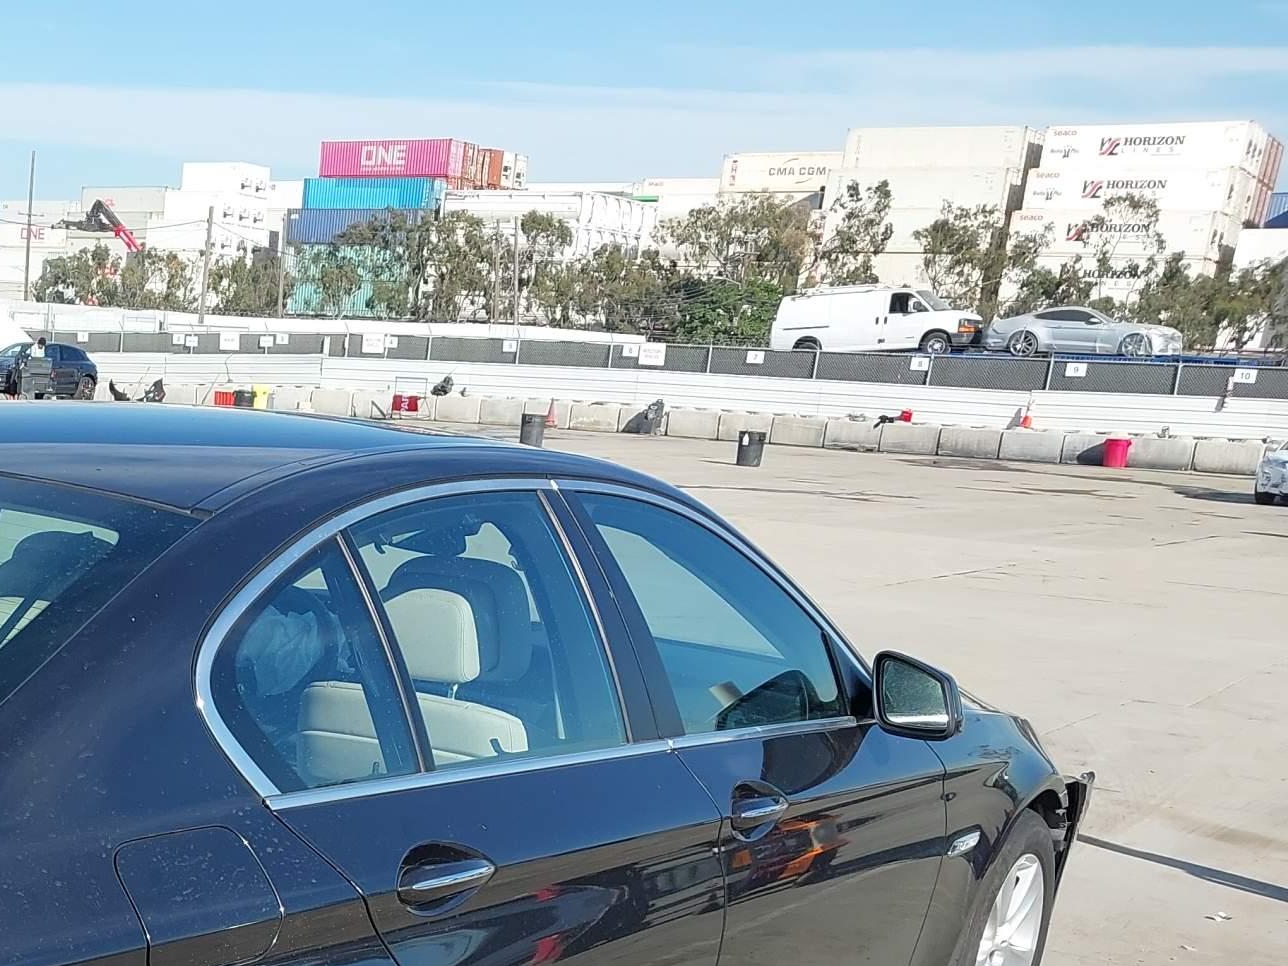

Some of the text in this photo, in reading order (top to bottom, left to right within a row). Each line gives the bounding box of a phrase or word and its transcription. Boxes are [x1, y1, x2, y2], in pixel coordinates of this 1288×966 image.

[1124, 136, 1187, 146] HORIZON
[360, 145, 407, 166] ONE
[769, 166, 827, 176] CMA CGM
[1106, 180, 1168, 189] HORIZON
[1073, 366, 1079, 374] 9
[1239, 372, 1251, 380] 10
